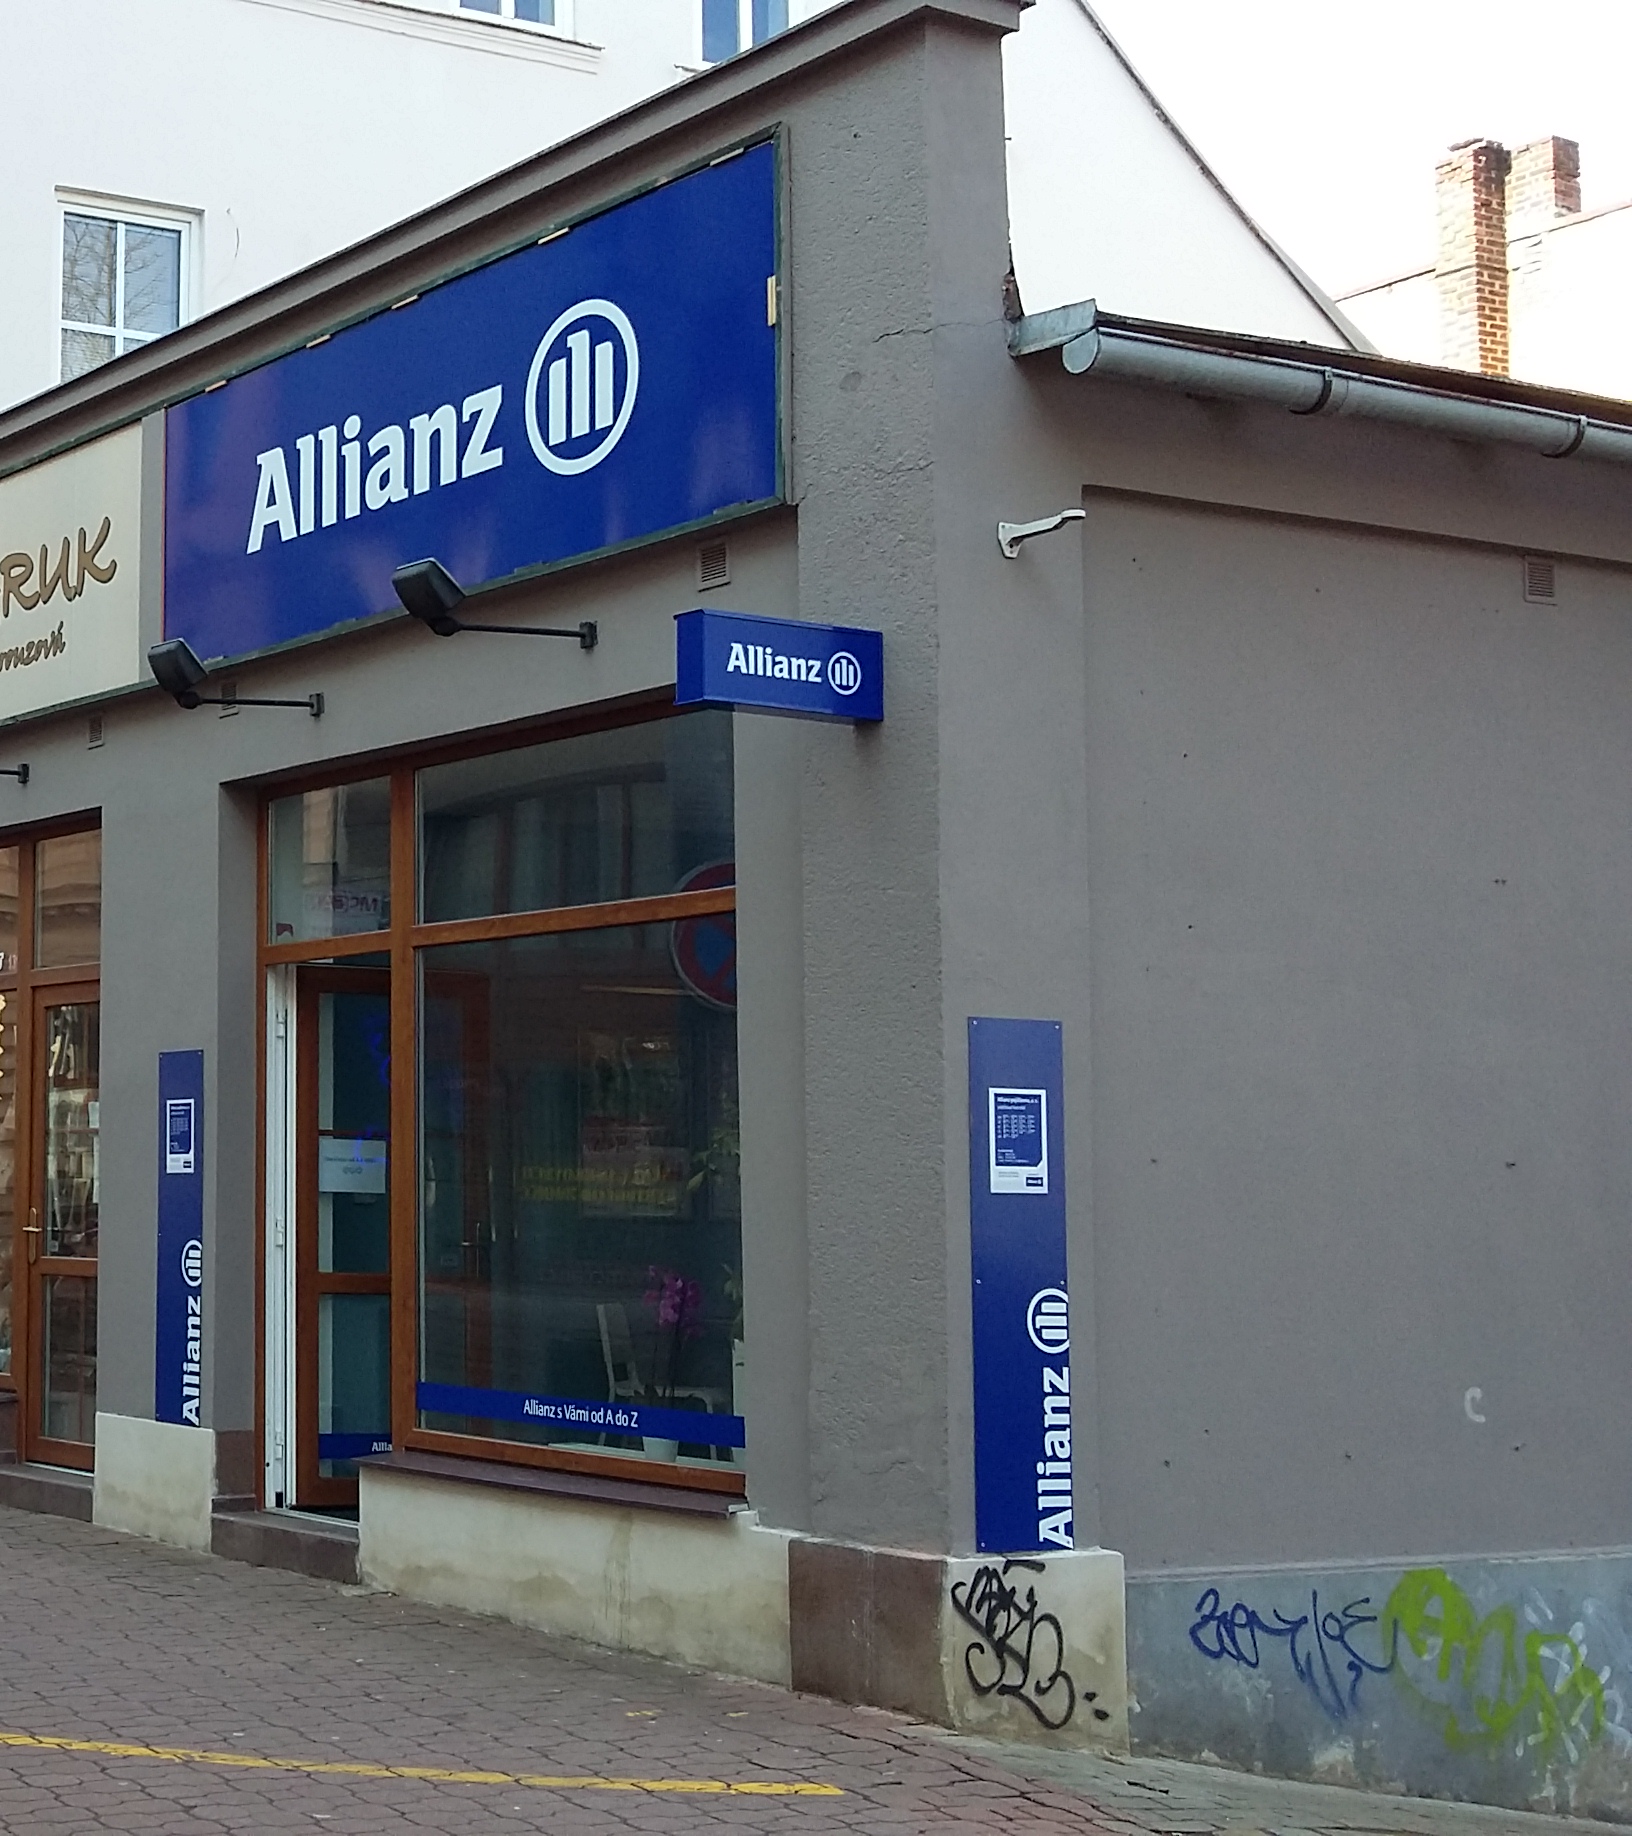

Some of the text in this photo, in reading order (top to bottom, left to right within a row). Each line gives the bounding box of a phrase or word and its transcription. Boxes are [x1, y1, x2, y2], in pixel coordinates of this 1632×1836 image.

[246, 384, 504, 555] Allianz
[726, 642, 822, 683] Allianz
[183, 1295, 200, 1426] Allianz
[523, 1399, 639, 1428] Allianz s Vámi od A do Z
[1037, 1366, 1074, 1550] Allianz
